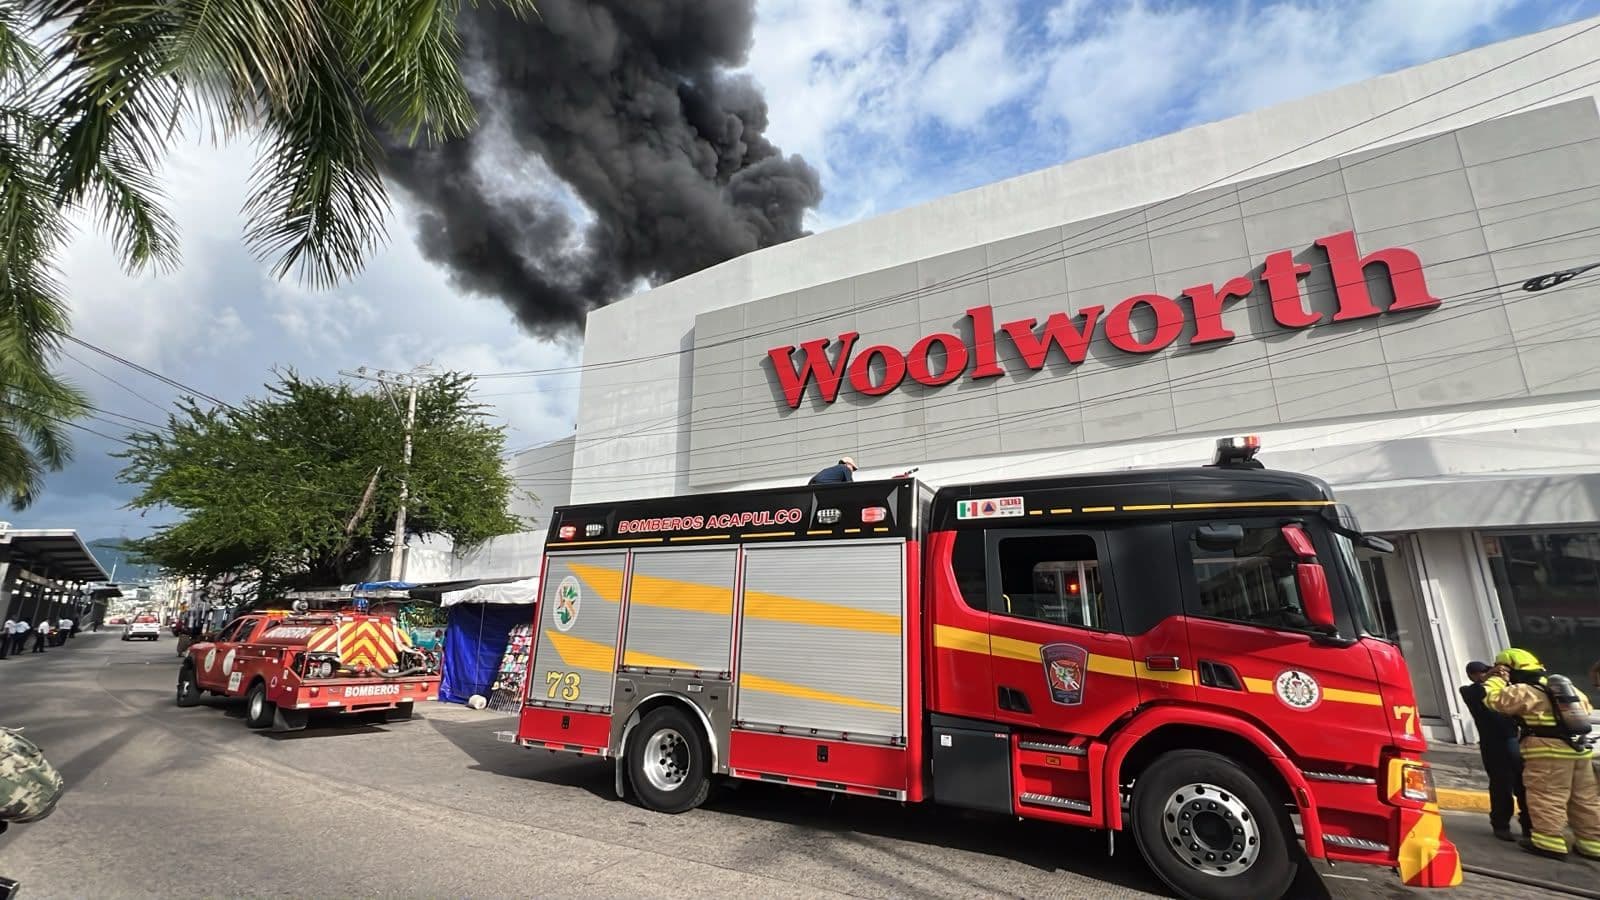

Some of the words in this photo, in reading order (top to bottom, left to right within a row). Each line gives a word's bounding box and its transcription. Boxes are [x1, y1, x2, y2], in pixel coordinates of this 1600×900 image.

[768, 231, 1442, 409] Woolworth
[618, 516, 703, 533] BOMBEROS
[706, 508, 802, 529] ACAPULCO
[344, 685, 400, 697] BOMBEROS
[546, 671, 581, 701] 73
[1393, 705, 1420, 736] 7
